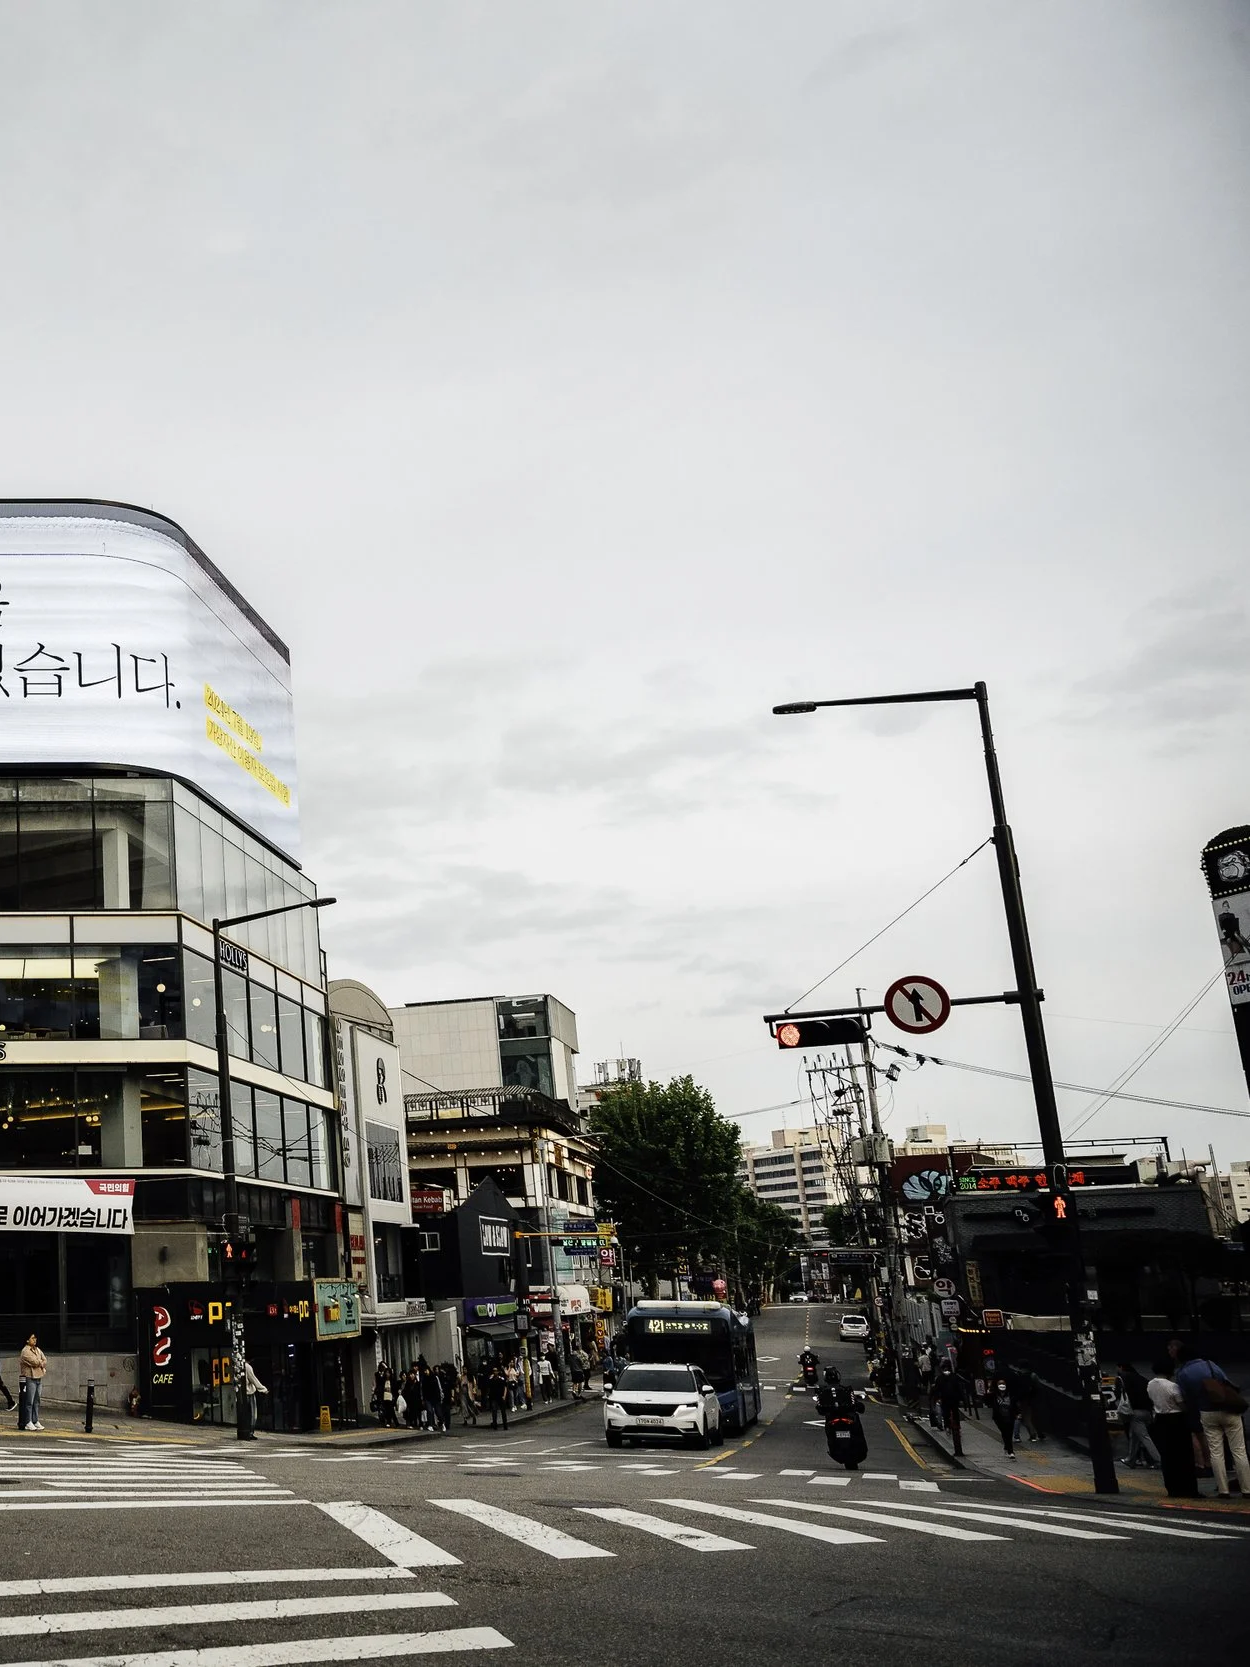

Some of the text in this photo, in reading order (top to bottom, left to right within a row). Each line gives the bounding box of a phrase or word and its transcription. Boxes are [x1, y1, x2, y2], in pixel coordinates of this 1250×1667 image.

[220, 940, 248, 971] HOLLYS
[99, 1182, 130, 1192] 국민의힘
[424, 1196, 442, 1204] Kebab
[13, 1206, 128, 1228] 이어가겠습니다
[936, 1280, 952, 1295] 약
[487, 1303, 496, 1317] CU
[648, 1320, 664, 1333] 421
[152, 1374, 174, 1384] CAFE
